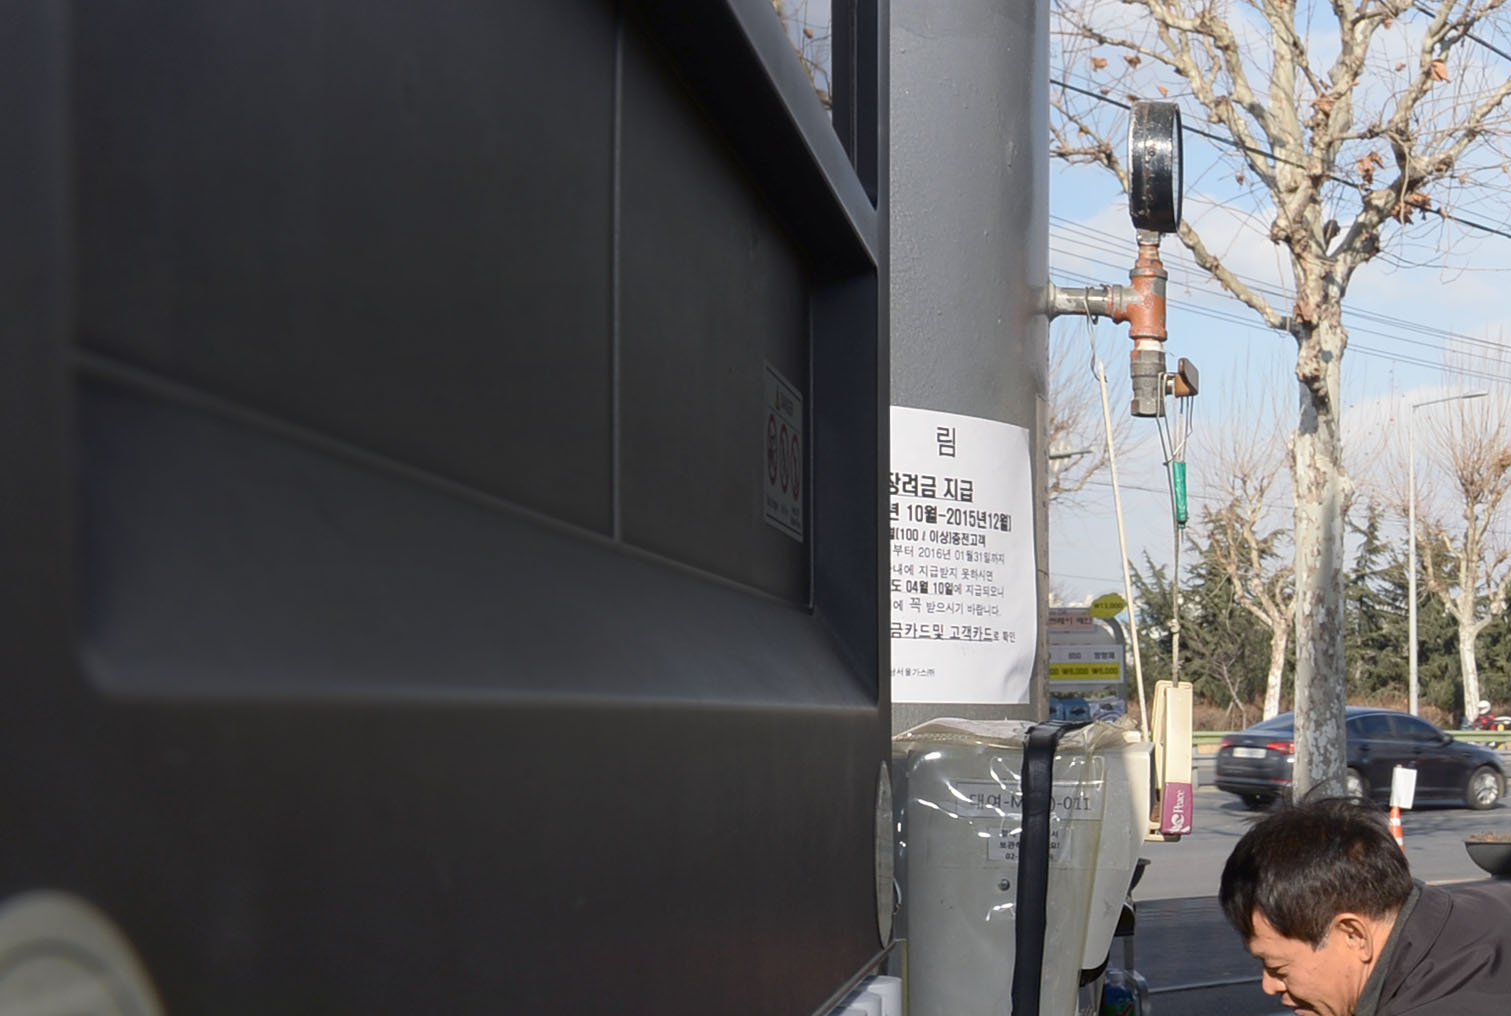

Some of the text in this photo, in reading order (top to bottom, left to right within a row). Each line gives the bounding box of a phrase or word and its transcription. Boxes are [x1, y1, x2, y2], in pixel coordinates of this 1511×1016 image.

[936, 426, 956, 458] 림
[943, 477, 973, 502] 지급
[918, 546, 951, 560] 2016년
